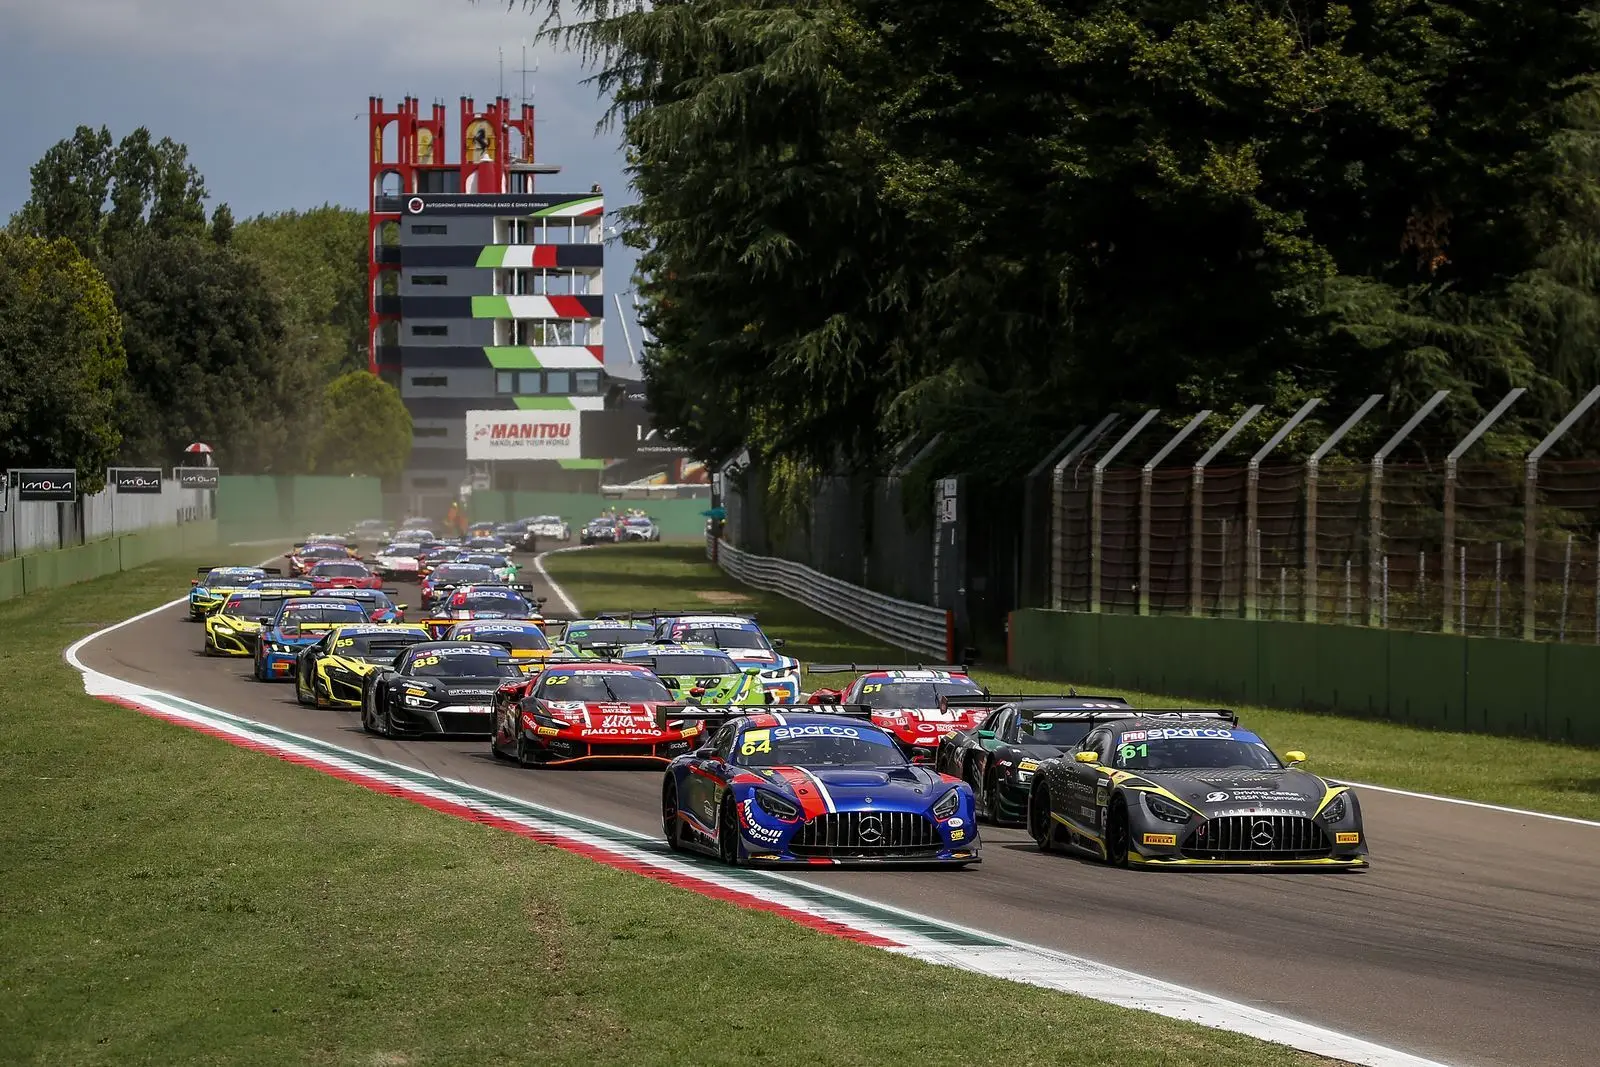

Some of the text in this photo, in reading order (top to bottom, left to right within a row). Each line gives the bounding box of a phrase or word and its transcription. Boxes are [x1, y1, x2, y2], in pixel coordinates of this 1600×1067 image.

[491, 423, 571, 439] MANITOU
[466, 591, 507, 599] sparco
[672, 630, 683, 639] 2
[336, 638, 354, 648] 55
[431, 647, 490, 656] sparco
[412, 656, 439, 668] 88
[545, 676, 570, 685] 62
[862, 683, 882, 694] 51
[774, 726, 859, 738] sparco
[1124, 728, 1233, 742] PRO sparco
[741, 740, 772, 756] 64
[1120, 744, 1148, 759] 61
[1214, 807, 1307, 817] FLOW TRADERS
[743, 798, 784, 838] Antonelli
[748, 828, 779, 844] Sport
[950, 831, 964, 839] OMP
[1146, 835, 1174, 844] PIRELLI
[1338, 834, 1358, 843] PIRELLI
